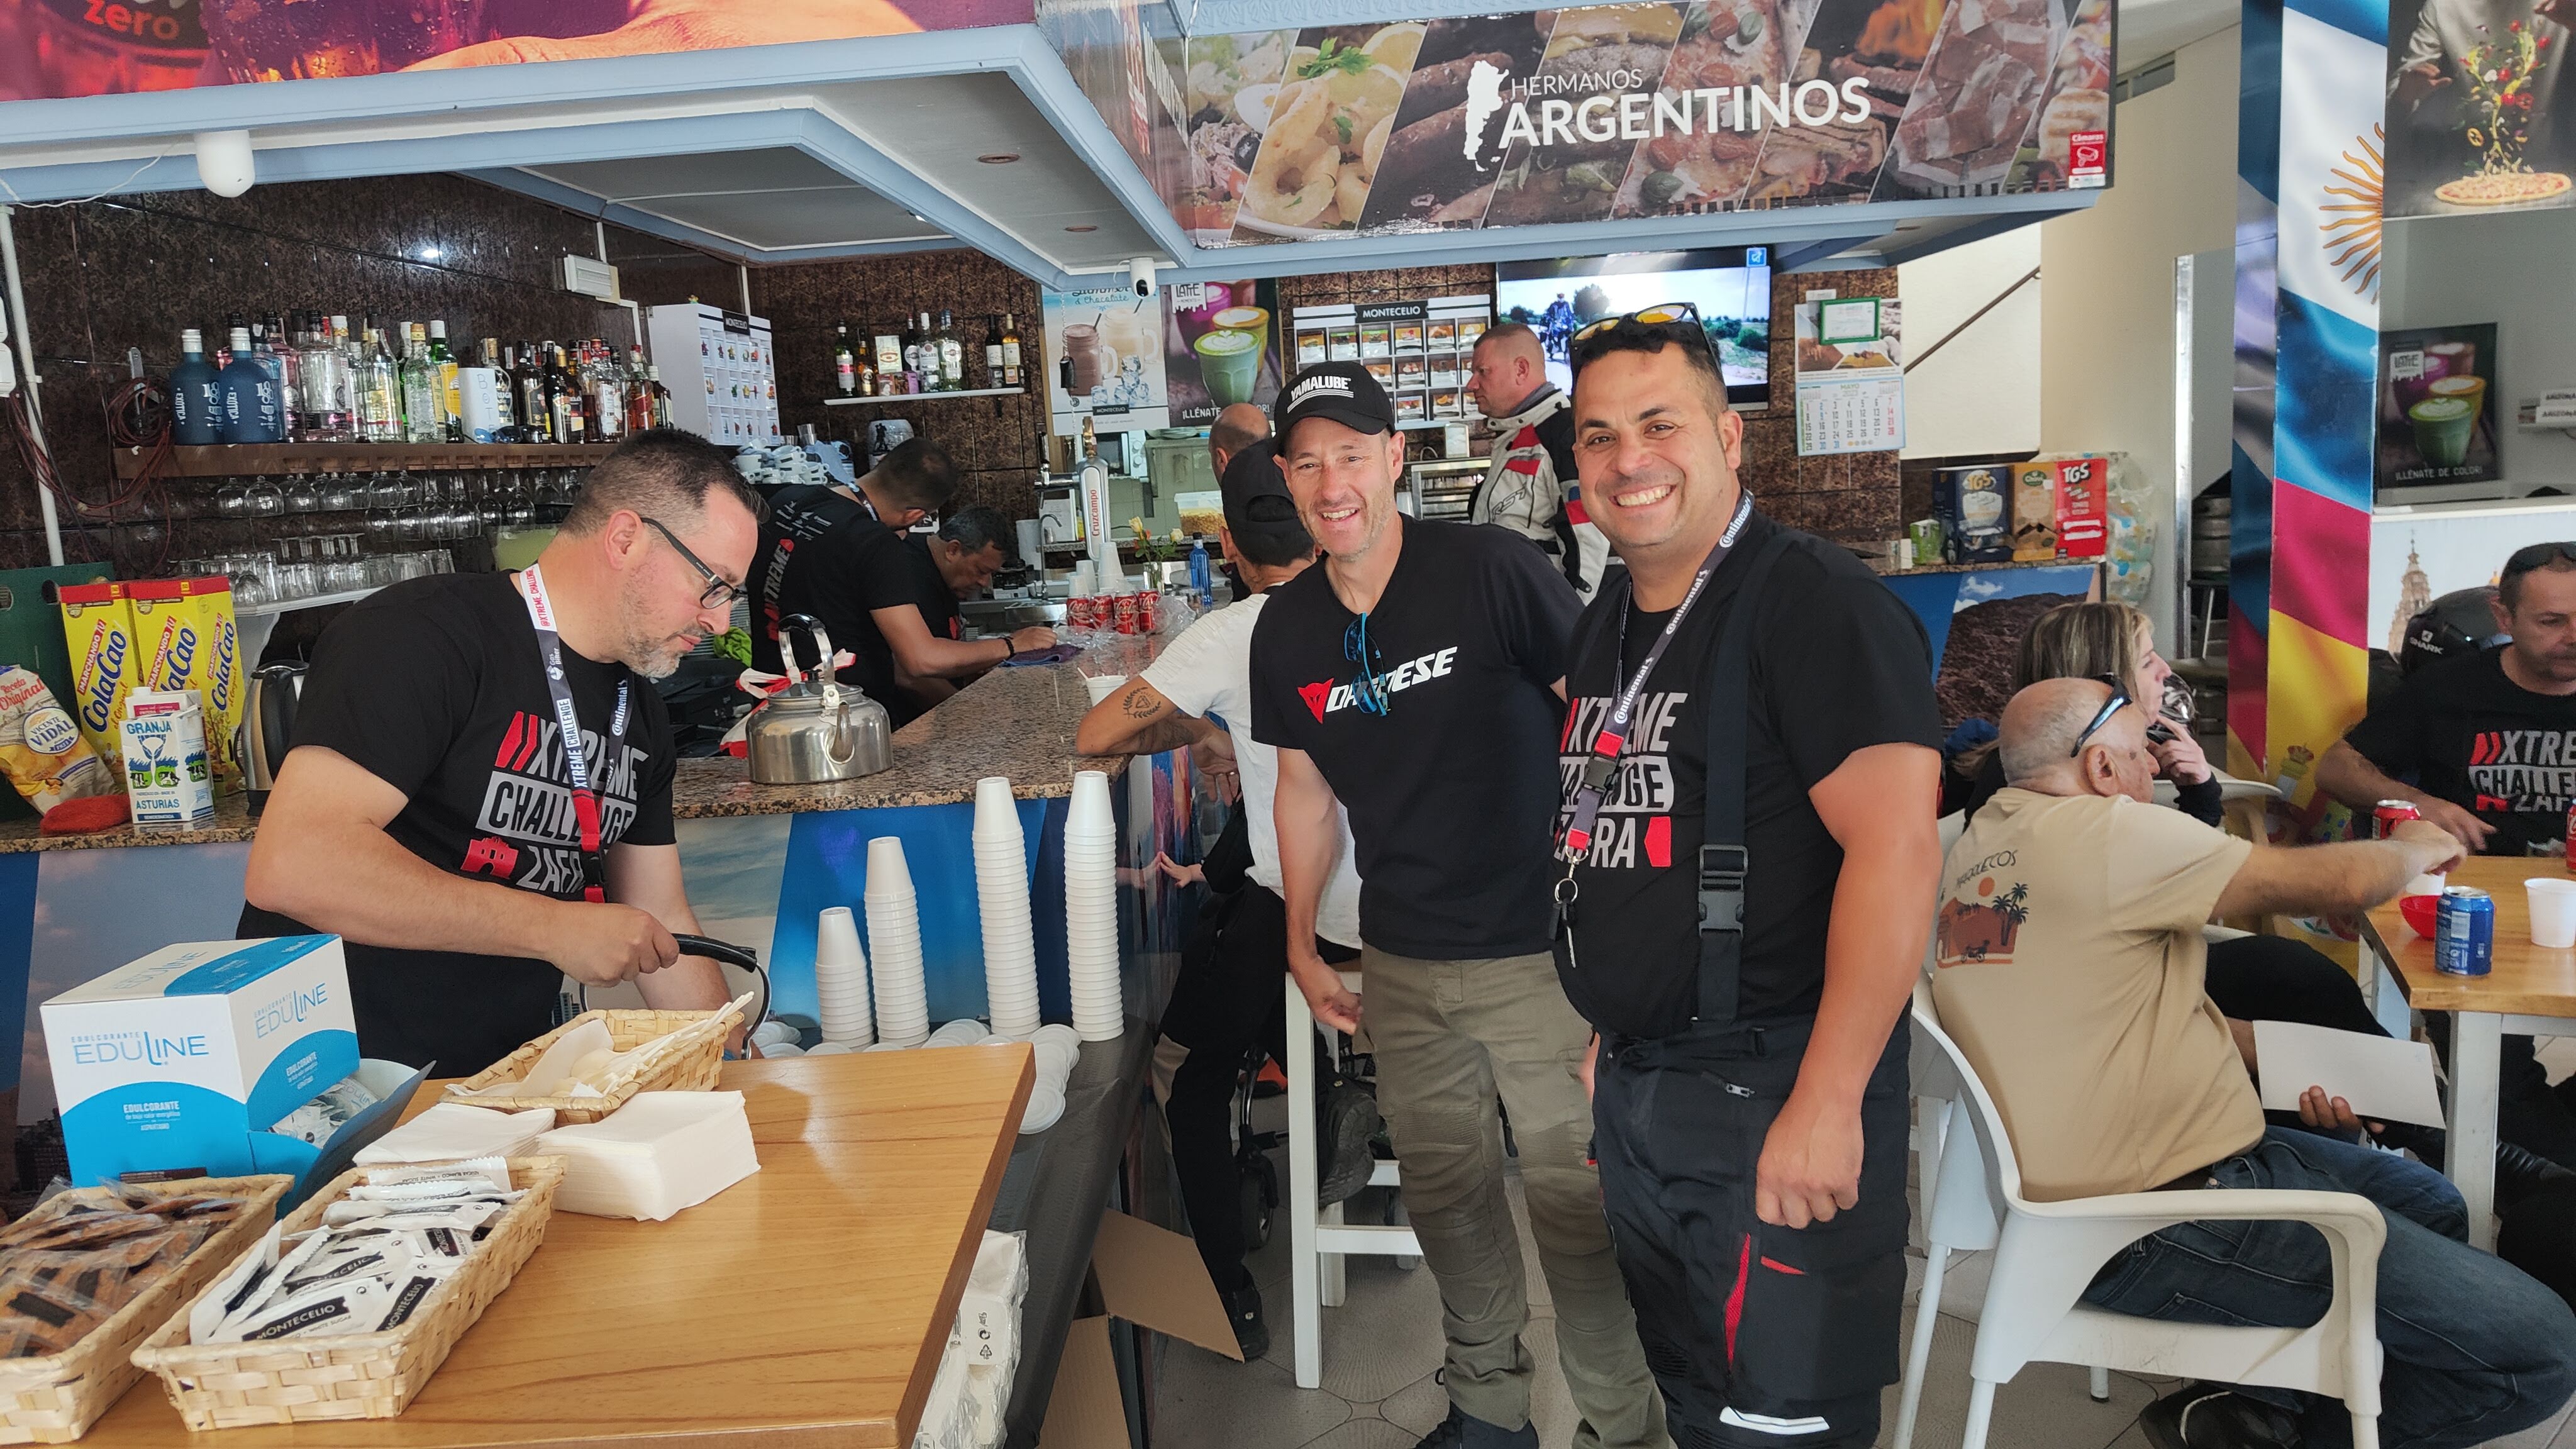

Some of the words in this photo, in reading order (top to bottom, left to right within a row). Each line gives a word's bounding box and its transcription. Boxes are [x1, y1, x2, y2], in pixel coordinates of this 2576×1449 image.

[84, 0, 180, 40] zero
[1512, 69, 1643, 97] HERMANOS
[1498, 76, 1872, 149] ARGENTINOS
[1084, 295, 1130, 304] Chocolate
[1362, 306, 1421, 319] MONTECELIO
[1291, 375, 1350, 401] YAMALUBE
[1968, 471, 1992, 491] TGS
[2063, 462, 2091, 484] TGS
[2438, 467, 2450, 477] DE
[1092, 489, 1100, 536] Cruzcampo
[1666, 577, 1704, 635] Continental
[160, 628, 197, 691] laCao
[2409, 636, 2443, 656] SHARK
[82, 631, 127, 733] ColaCao
[211, 621, 235, 711] ColaCao
[0, 679, 45, 711] Original
[1614, 663, 1649, 724] Continental
[30, 716, 62, 735] VICENTE
[560, 699, 579, 747] CHALLENGE
[612, 686, 628, 736] Continental
[30, 720, 75, 747] VIDAL
[126, 721, 172, 735] GRANJA
[569, 750, 588, 789] XTREME
[136, 798, 180, 809] ASTURIAS
[255, 982, 328, 1039] EDULINE
[71, 1031, 140, 1043] EDULCORANTE
[74, 1031, 209, 1066] EDULINE
[123, 1101, 180, 1113] EDULCORANTE
[255, 1304, 336, 1340] MONTECELIO
